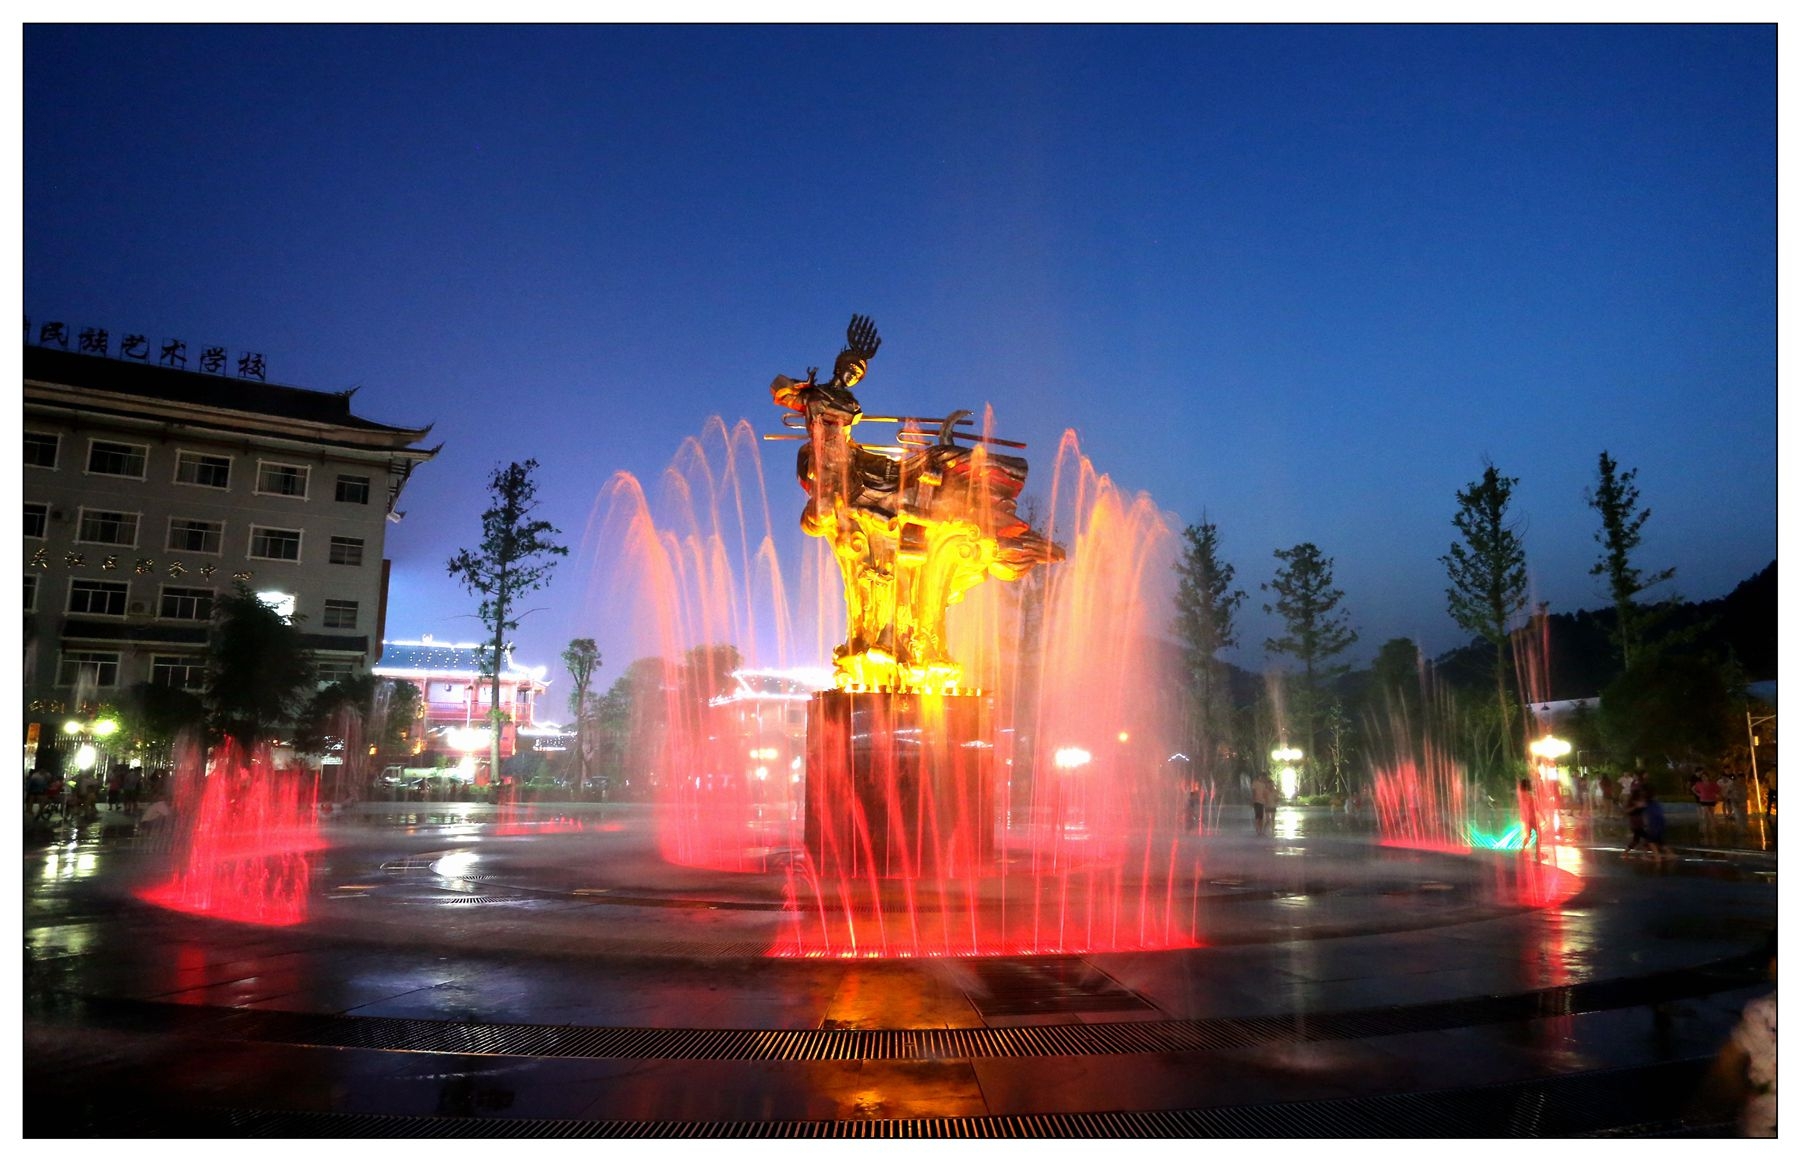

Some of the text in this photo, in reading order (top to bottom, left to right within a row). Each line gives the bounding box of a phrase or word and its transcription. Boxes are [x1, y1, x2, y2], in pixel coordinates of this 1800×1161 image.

[23, 316, 266, 379] 民族艺术学校
